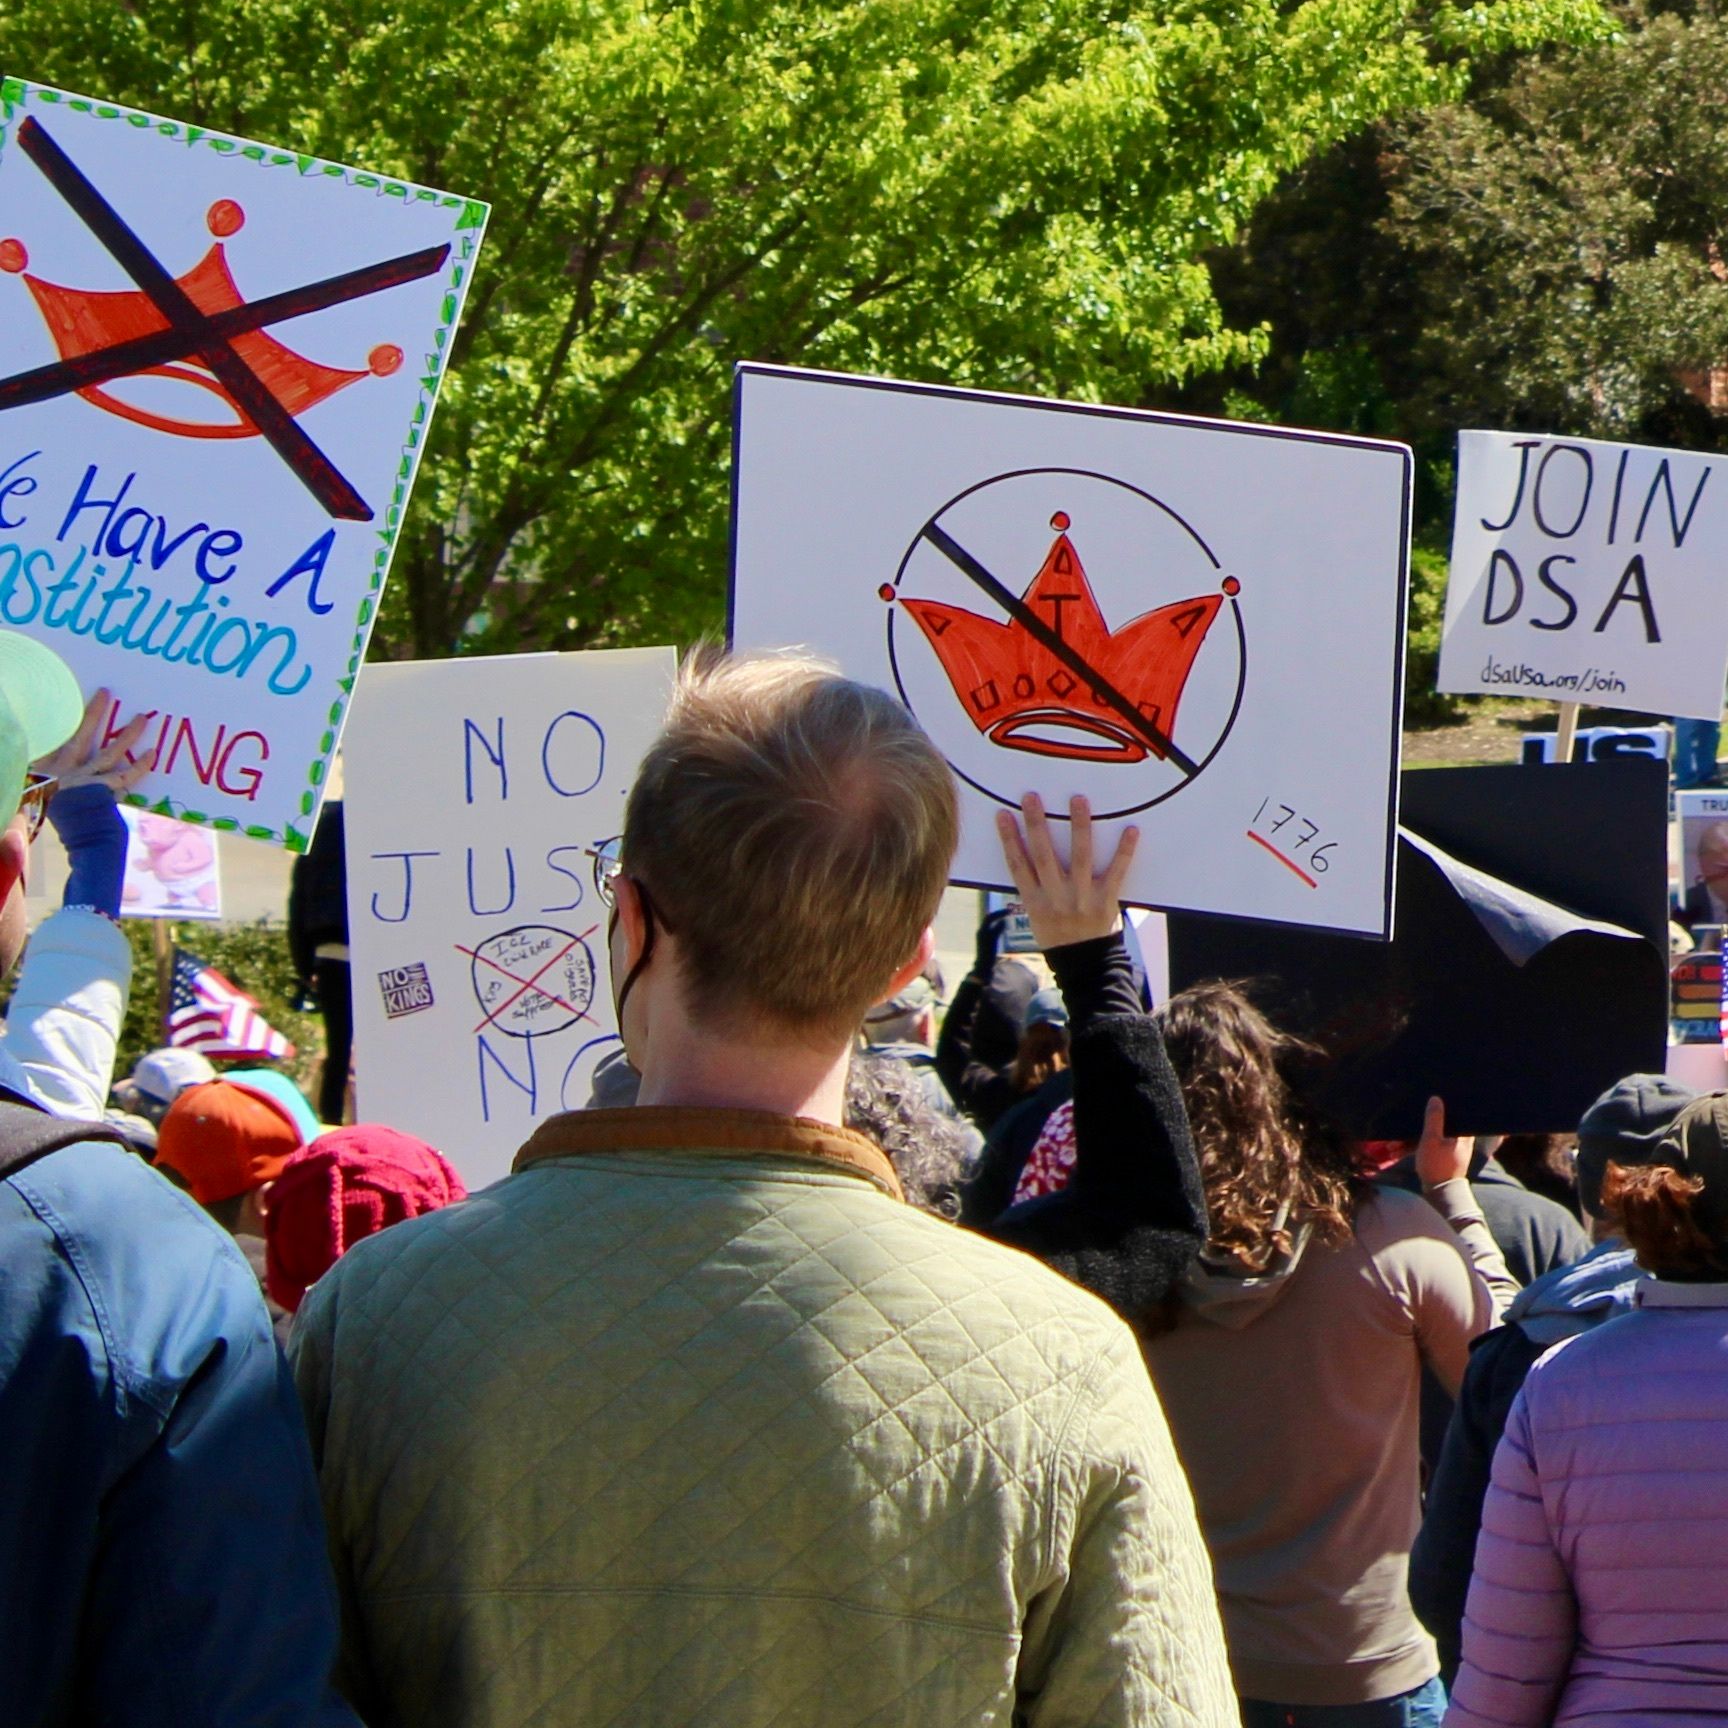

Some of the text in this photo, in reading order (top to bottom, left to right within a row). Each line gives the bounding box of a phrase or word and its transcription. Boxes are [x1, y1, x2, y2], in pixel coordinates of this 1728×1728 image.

[0, 450, 336, 615] e Have A
[1480, 440, 1712, 549] JOIN
[1482, 547, 1662, 644] DSA
[1251, 795, 1340, 876] 1776
[371, 839, 611, 923] JUS
[381, 968, 410, 991] NO
[384, 981, 433, 1013] KINGS
